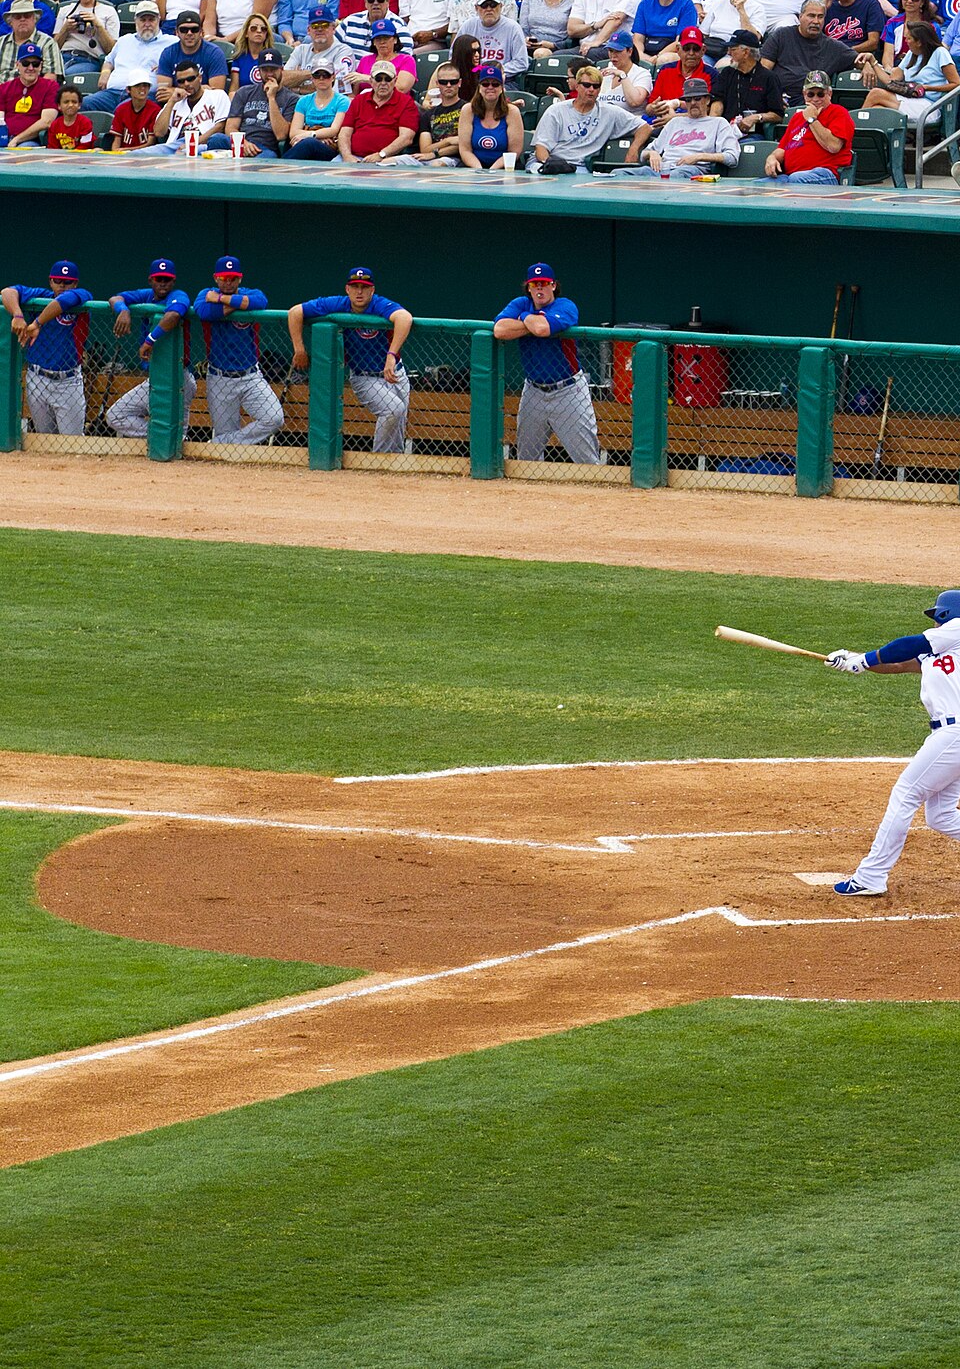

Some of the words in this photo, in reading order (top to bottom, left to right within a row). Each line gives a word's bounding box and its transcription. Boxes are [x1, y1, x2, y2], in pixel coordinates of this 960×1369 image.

[825, 17, 860, 38] Cubs
[848, 29, 862, 40] 29
[482, 49, 504, 61] UBS
[599, 95, 627, 104] HICAGO
[669, 130, 706, 146] Cubs
